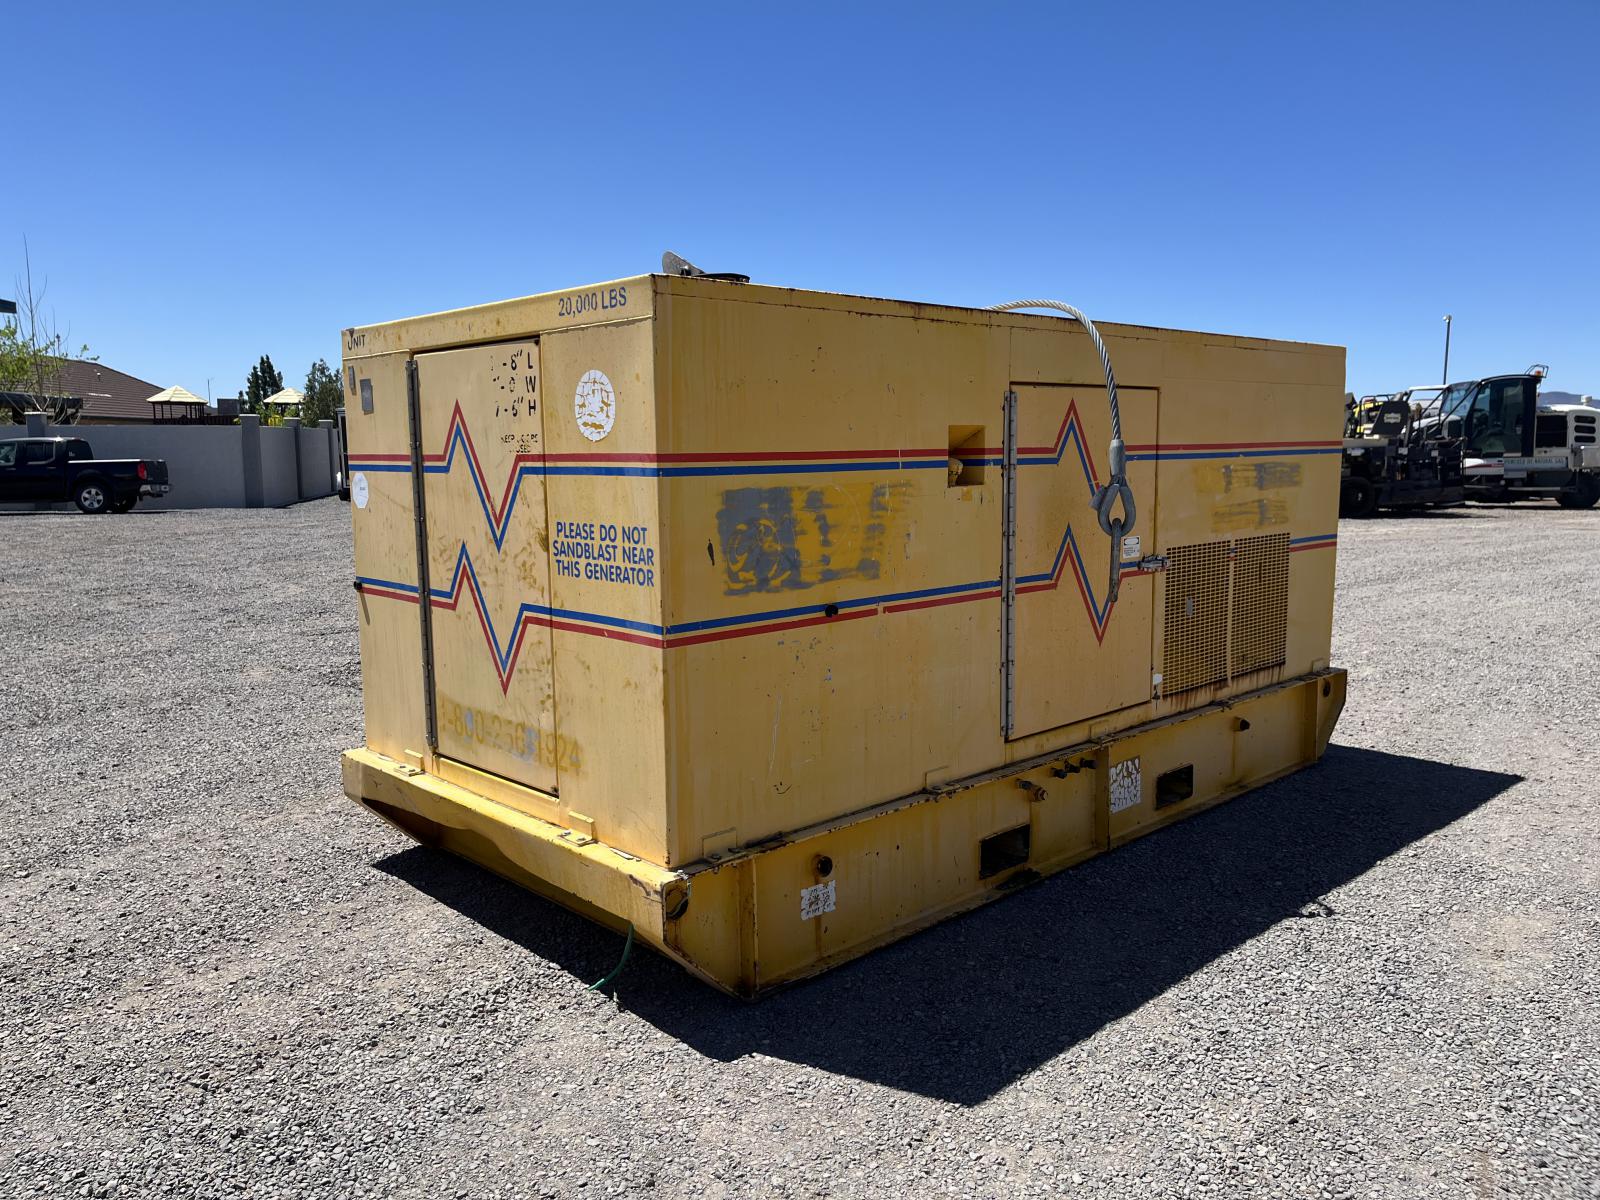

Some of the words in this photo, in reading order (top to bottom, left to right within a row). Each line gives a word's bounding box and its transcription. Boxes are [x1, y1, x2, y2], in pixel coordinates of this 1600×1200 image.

[558, 291, 598, 318] 20,000
[601, 286, 627, 310] LBS
[527, 351, 534, 370] L
[525, 375, 536, 393] W
[528, 398, 537, 417] H
[556, 521, 595, 541] PLEASE
[600, 524, 617, 543] DO
[622, 525, 648, 545] NOT
[552, 540, 618, 563] SANDBLAST
[622, 545, 654, 566] NEAR
[555, 559, 581, 578] THIS
[584, 562, 655, 588] GENERATOR
